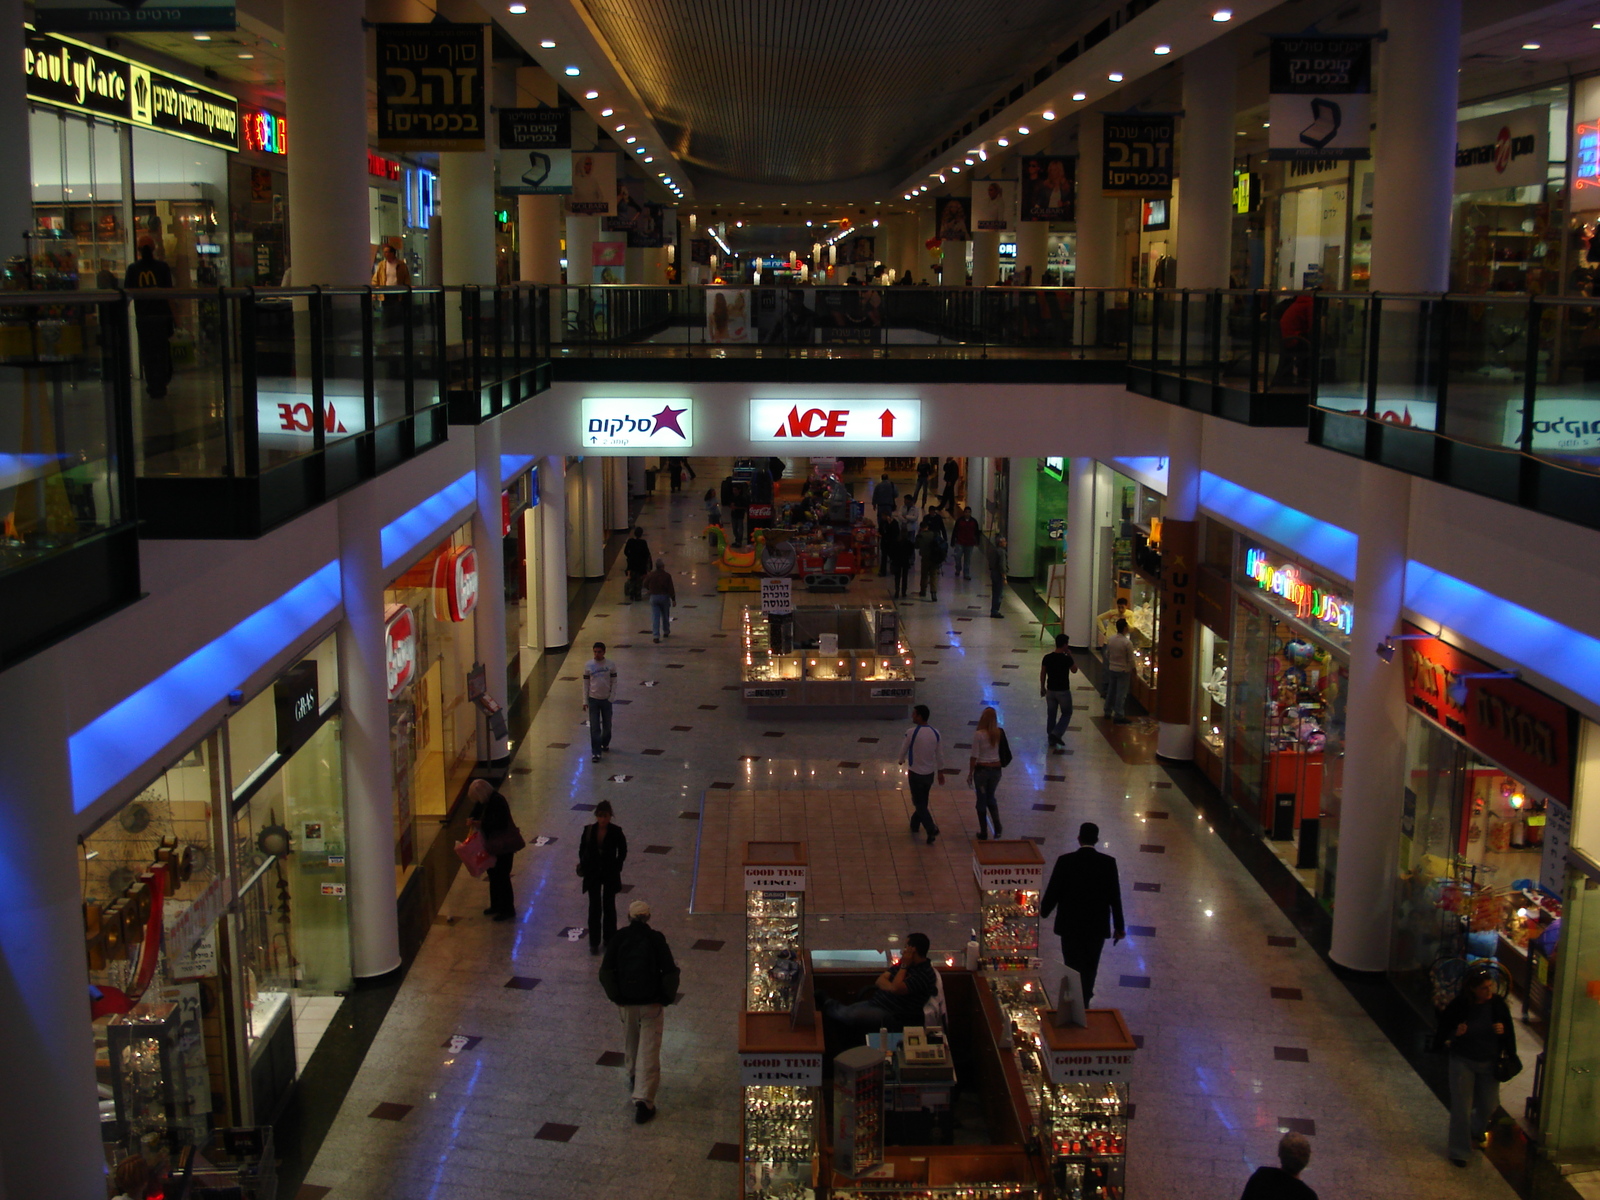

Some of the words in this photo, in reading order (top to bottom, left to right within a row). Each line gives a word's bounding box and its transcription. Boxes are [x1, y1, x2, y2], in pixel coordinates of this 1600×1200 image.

[88, 10, 131, 21] בחנות
[137, 9, 181, 21] פרטים
[385, 44, 429, 61] שנה
[438, 44, 477, 67] סוף
[1289, 59, 1310, 74] רק
[1314, 59, 1350, 73] קונים
[386, 67, 478, 105] זהב
[513, 124, 527, 135] רק
[531, 124, 557, 134] קונים
[1108, 126, 1139, 138] שנה
[1144, 126, 1170, 142] סוף
[1109, 142, 1170, 167] זהב
[588, 414, 652, 437] סלקום
[774, 404, 850, 437] ACE
[763, 591, 790, 599] מוכרת
[763, 599, 790, 608] מנוסה
[295, 688, 315, 722] GRAS
[743, 1059, 781, 1067] GOOD
[785, 1058, 821, 1067] TIME
[1055, 1056, 1092, 1064] GOOD
[1096, 1055, 1131, 1064] TIME
